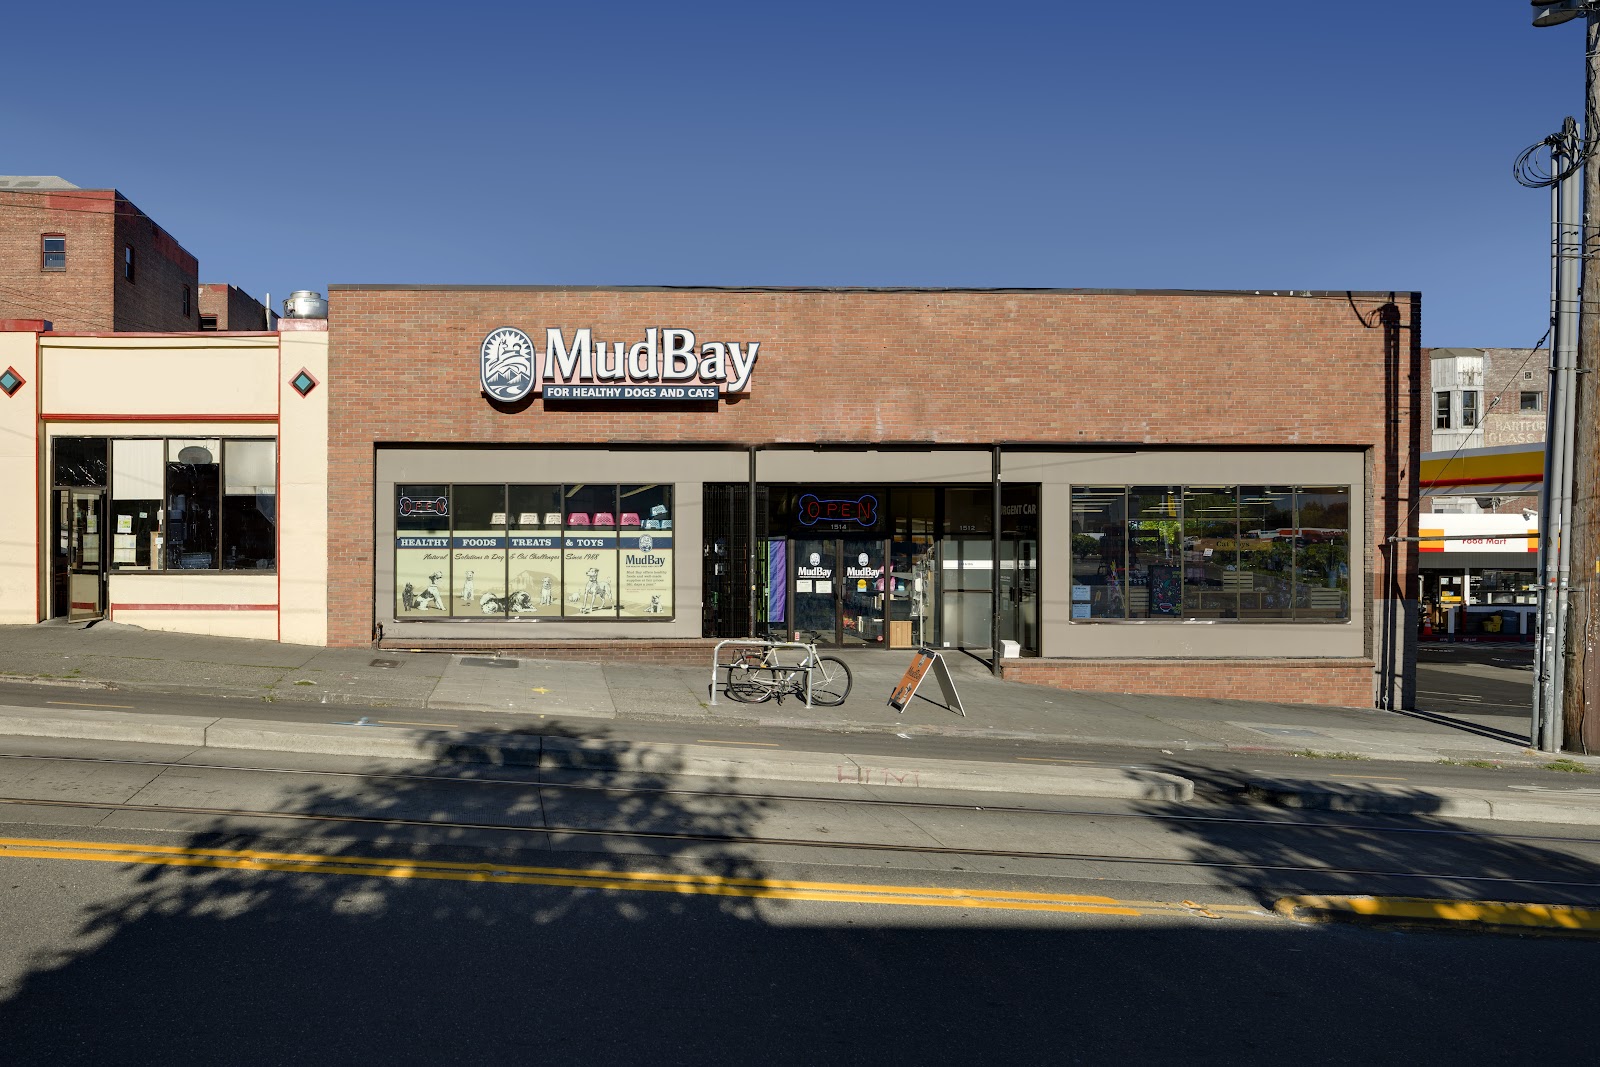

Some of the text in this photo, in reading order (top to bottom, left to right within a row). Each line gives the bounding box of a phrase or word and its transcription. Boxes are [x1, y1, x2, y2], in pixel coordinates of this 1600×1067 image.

[542, 327, 760, 392] MudBay
[547, 387, 715, 398] FOR HEALTHY DOGS AND CATS
[1488, 432, 1535, 443] GLASS
[403, 501, 445, 512] OPEN
[807, 501, 871, 519] OPEN
[400, 538, 604, 547] HEALTHY FOODS TREATS & TOYS
[422, 553, 449, 561] Natural
[491, 553, 505, 562] Dog
[528, 553, 560, 562] Challenges
[626, 554, 665, 567] MudBay
[798, 566, 832, 578] MudBay
[847, 566, 881, 578] MudBay
